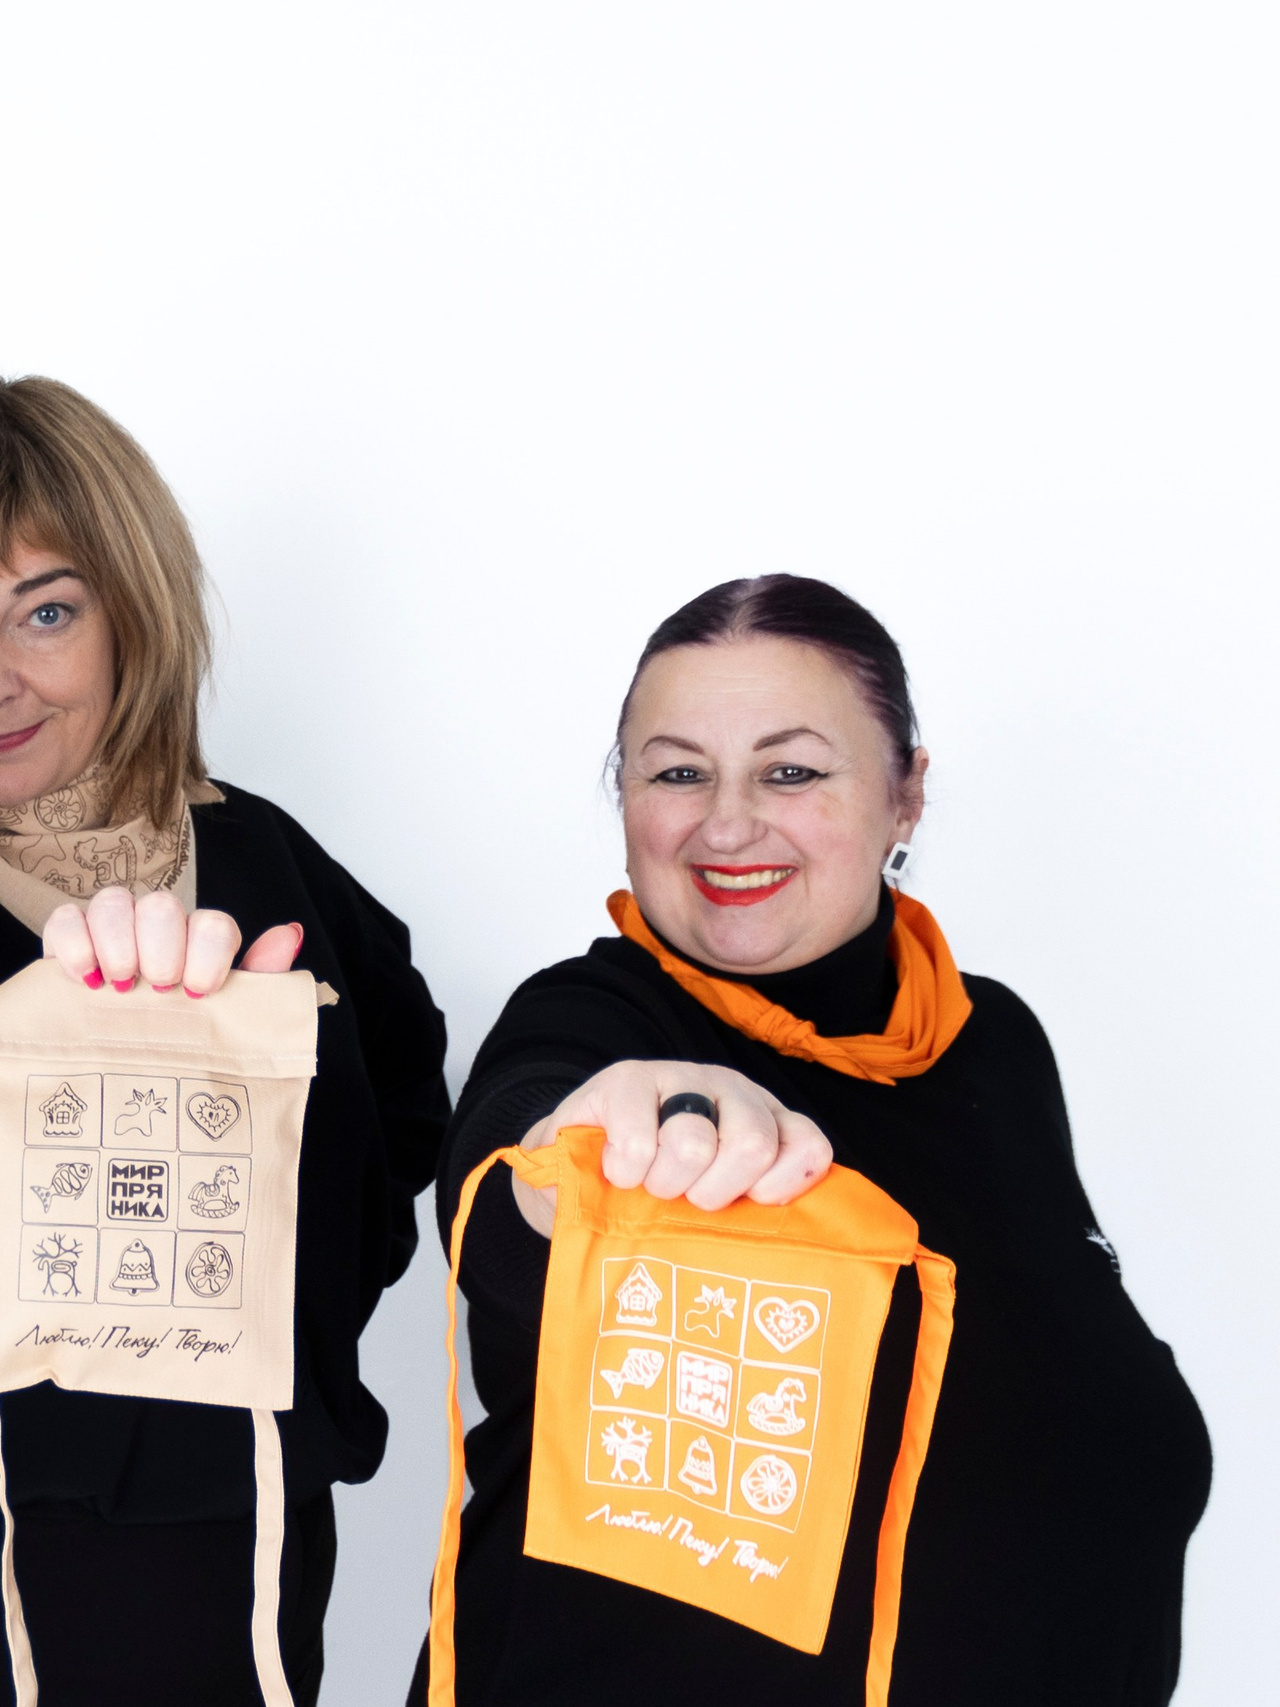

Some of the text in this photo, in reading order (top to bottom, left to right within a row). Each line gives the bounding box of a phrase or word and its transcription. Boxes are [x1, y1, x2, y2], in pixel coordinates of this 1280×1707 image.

[111, 1163, 164, 1179] МИР
[111, 1182, 163, 1198] ПРЯ
[111, 1200, 164, 1218] НИКА
[16, 1324, 242, 1361] Люблю! Пеку! Творю!
[586, 1503, 673, 1535] Люблю!
[668, 1514, 729, 1568] Пеку!
